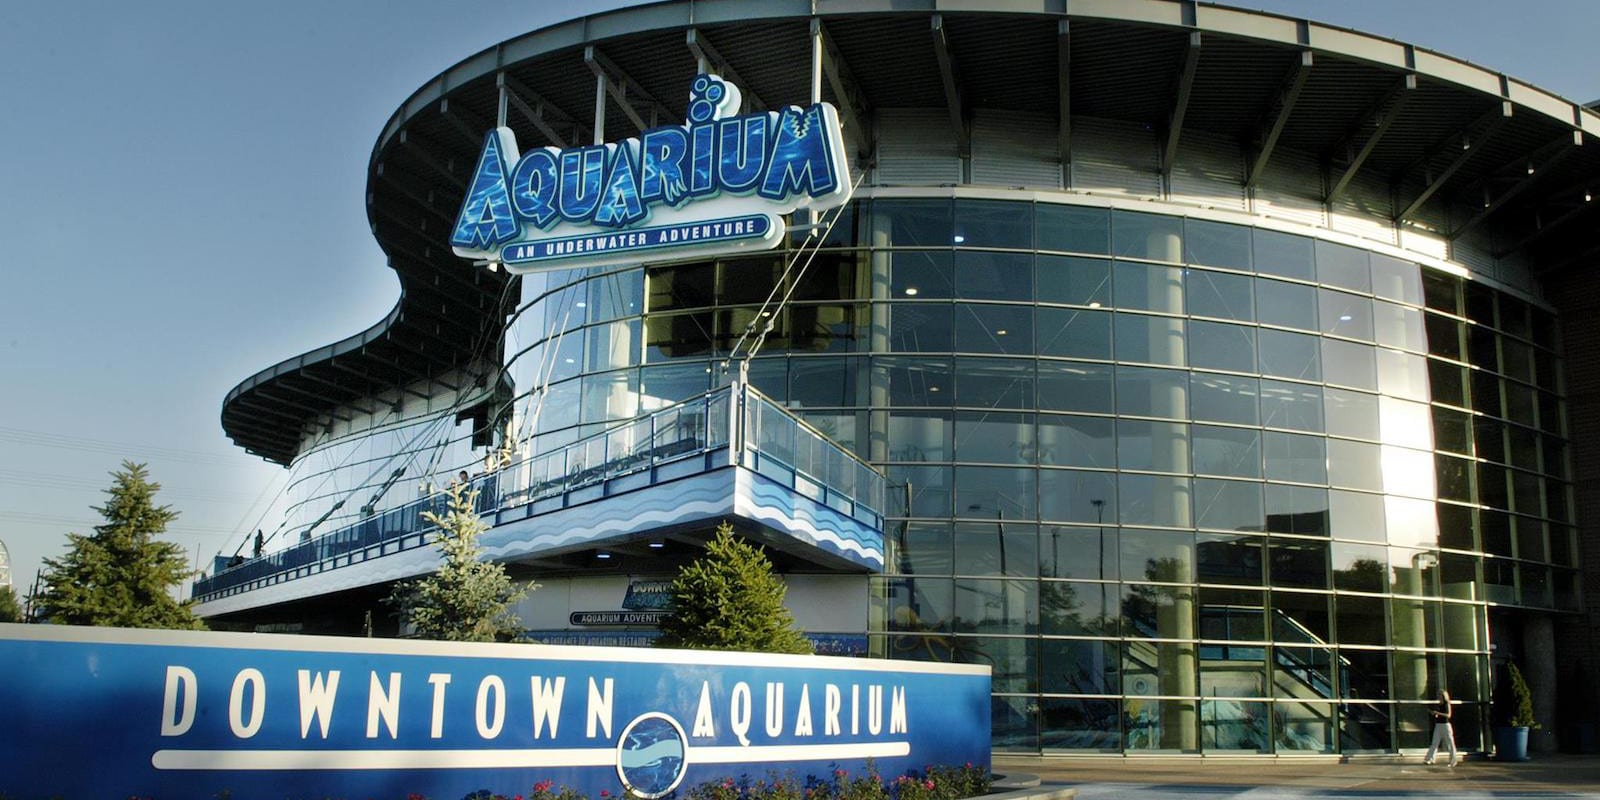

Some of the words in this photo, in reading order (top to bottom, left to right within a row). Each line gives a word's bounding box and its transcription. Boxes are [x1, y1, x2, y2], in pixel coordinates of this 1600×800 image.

[452, 73, 838, 248] AQUARIUM
[516, 245, 535, 260] AN
[546, 233, 647, 256] UNDERWATER
[660, 220, 755, 243] ADVENTURE
[581, 614, 620, 623] AQUARIUM
[587, 636, 618, 646] AQUARIUM
[160, 666, 615, 740] DOWNTOWN
[692, 680, 908, 747] AQUARIUM
